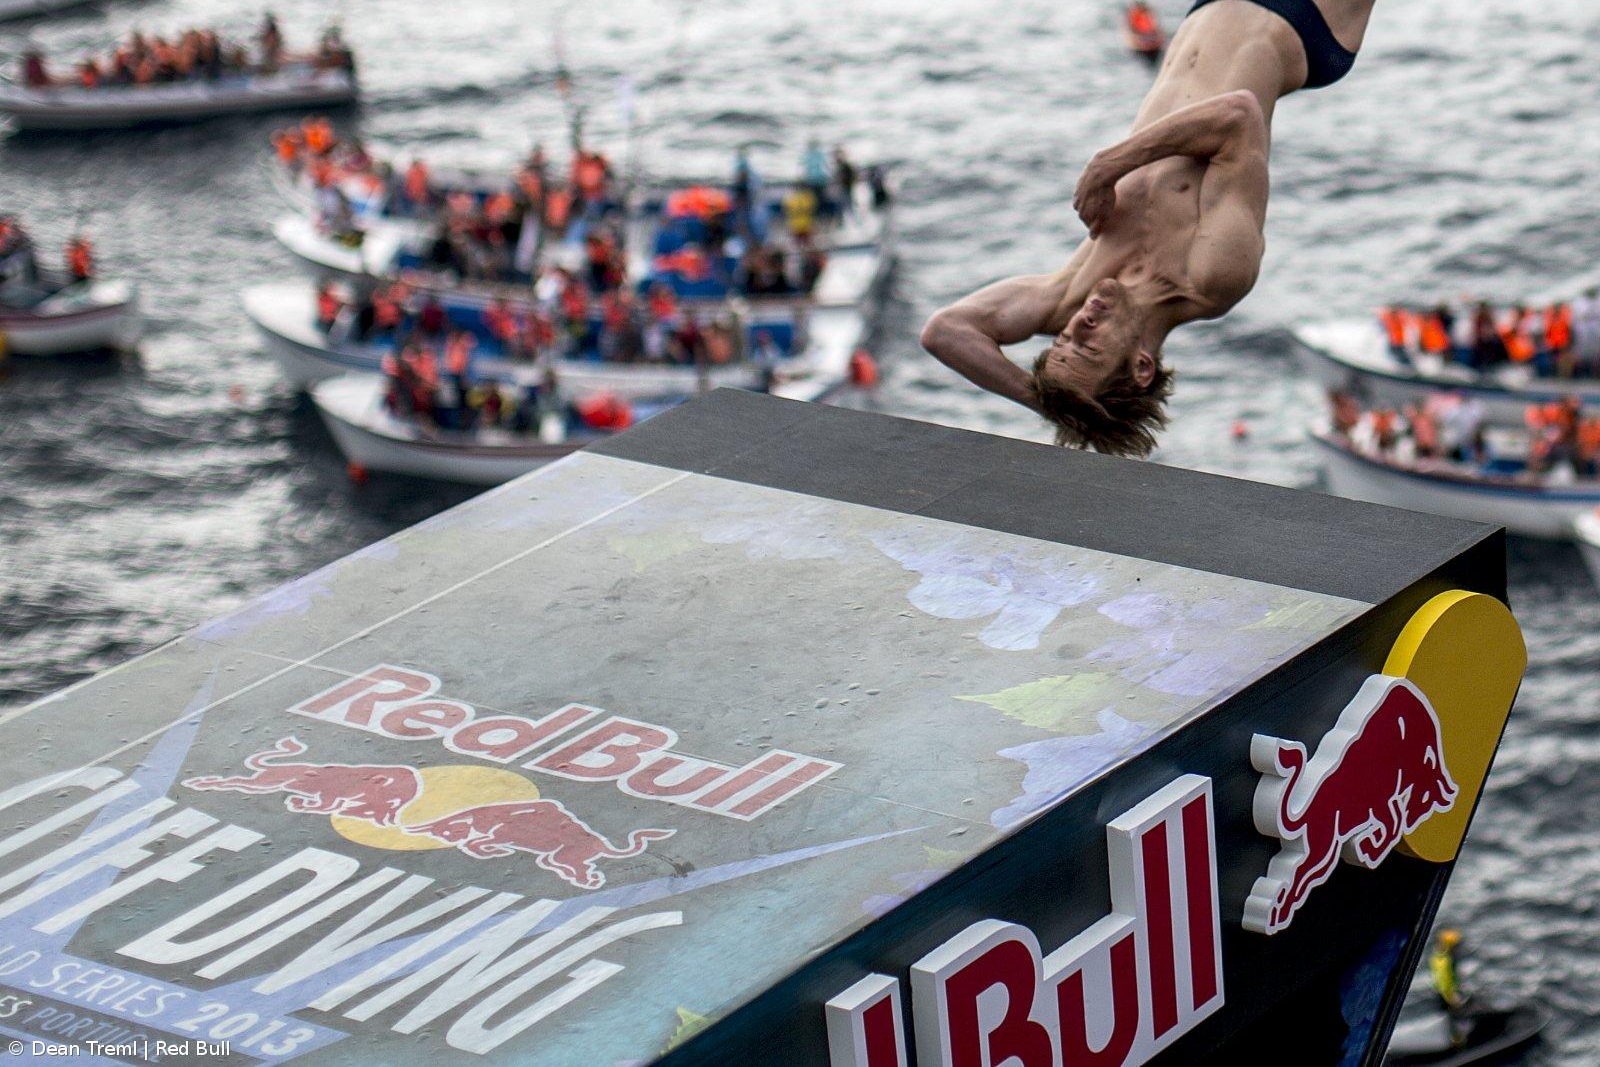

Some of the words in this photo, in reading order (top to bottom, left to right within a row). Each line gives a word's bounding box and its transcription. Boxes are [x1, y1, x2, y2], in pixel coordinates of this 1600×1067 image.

[288, 663, 601, 762] Red
[523, 713, 844, 821] Bull
[29, 962, 186, 1017] SERIES
[171, 1003, 315, 1056] 2013
[115, 847, 683, 1054] DIVING
[911, 774, 1225, 1067] Bull
